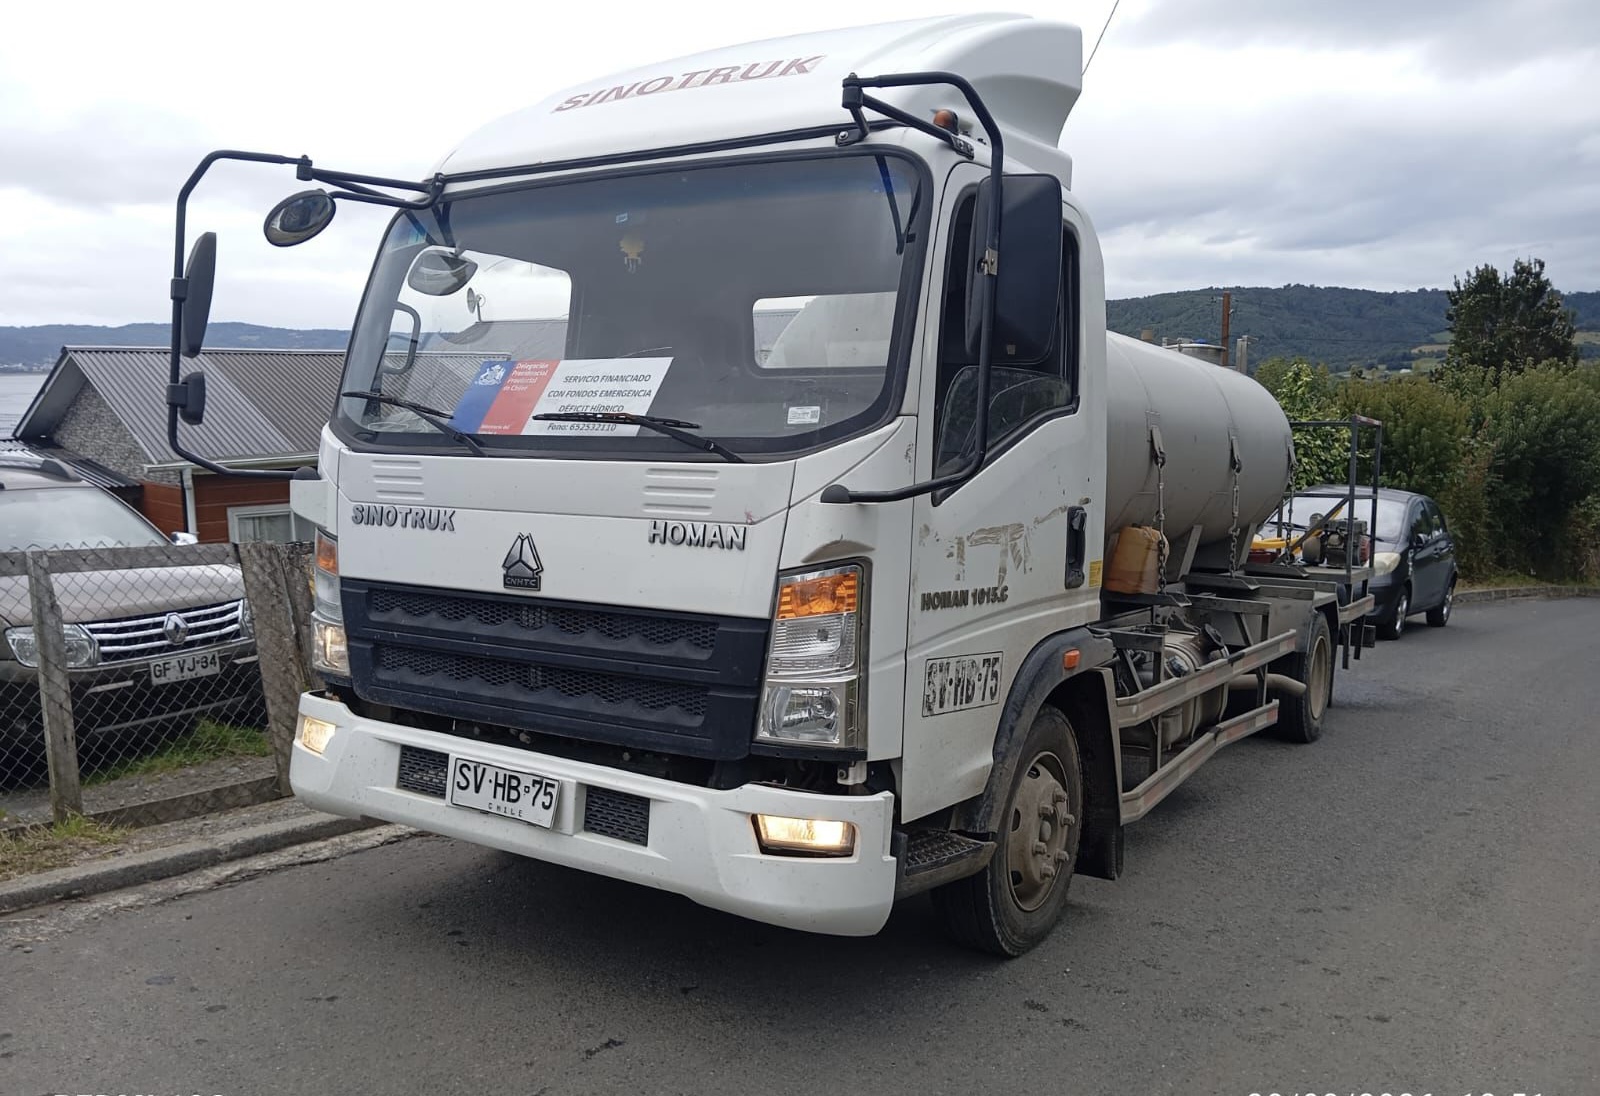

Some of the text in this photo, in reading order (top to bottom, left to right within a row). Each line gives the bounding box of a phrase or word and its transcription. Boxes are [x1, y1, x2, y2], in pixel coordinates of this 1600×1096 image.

[555, 55, 826, 112] SINOTRUK
[563, 374, 651, 383] SERVICIO FINANCIADO
[547, 388, 652, 398] CON FONDOS EMERGENCIA
[591, 403, 625, 413] HÍDRICO
[547, 422, 617, 432] Fono: 652532110
[351, 504, 456, 532] SINOTRUK
[648, 520, 747, 551] HOMAN
[920, 589, 969, 612] HOMAN
[487, 802, 523, 818] CHILE
